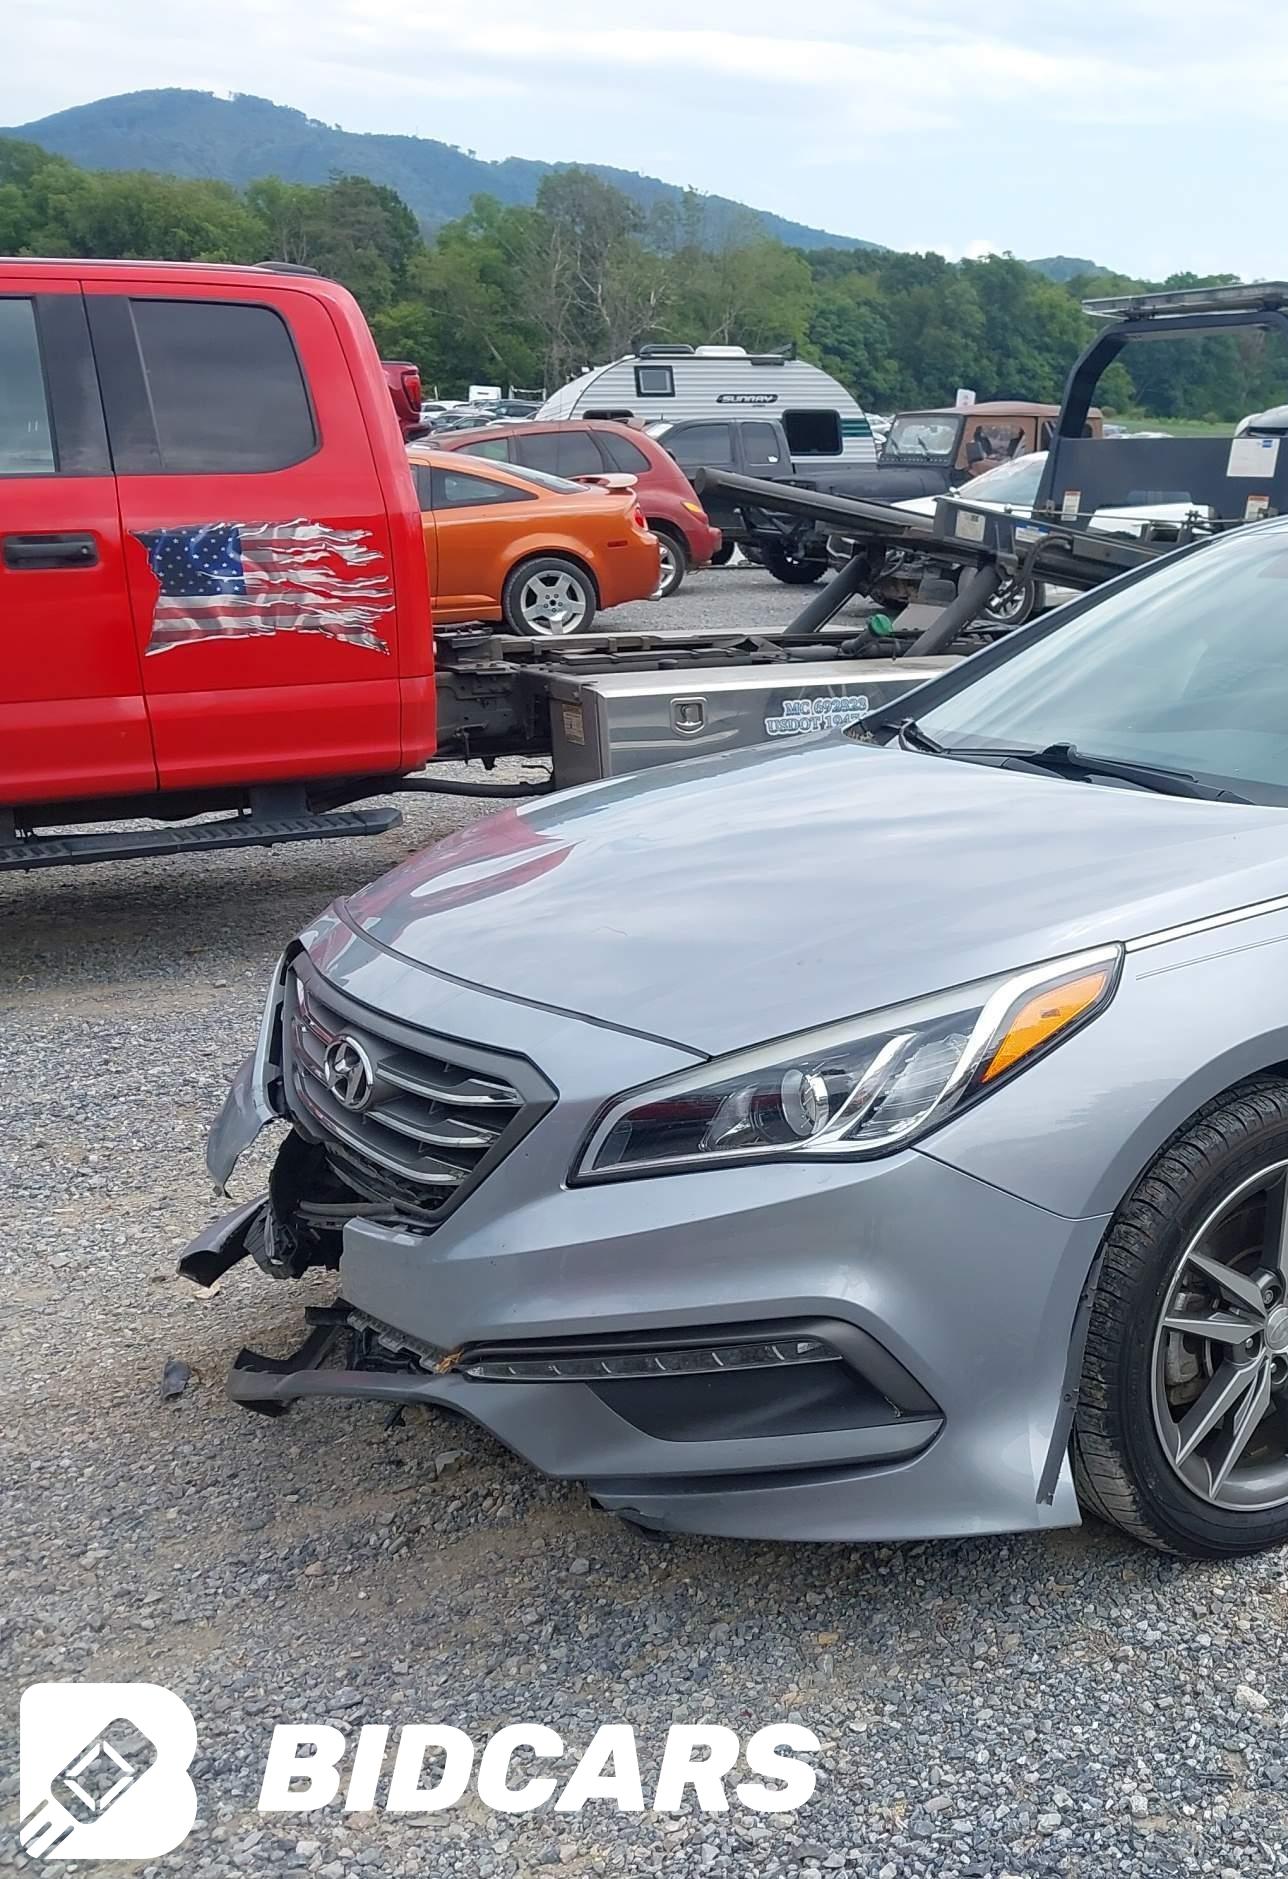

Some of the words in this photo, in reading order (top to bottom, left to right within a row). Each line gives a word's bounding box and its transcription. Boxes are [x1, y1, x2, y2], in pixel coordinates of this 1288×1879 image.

[720, 394, 775, 403] SUNRAY
[784, 700, 811, 716] MC
[765, 715, 821, 733] USDOT
